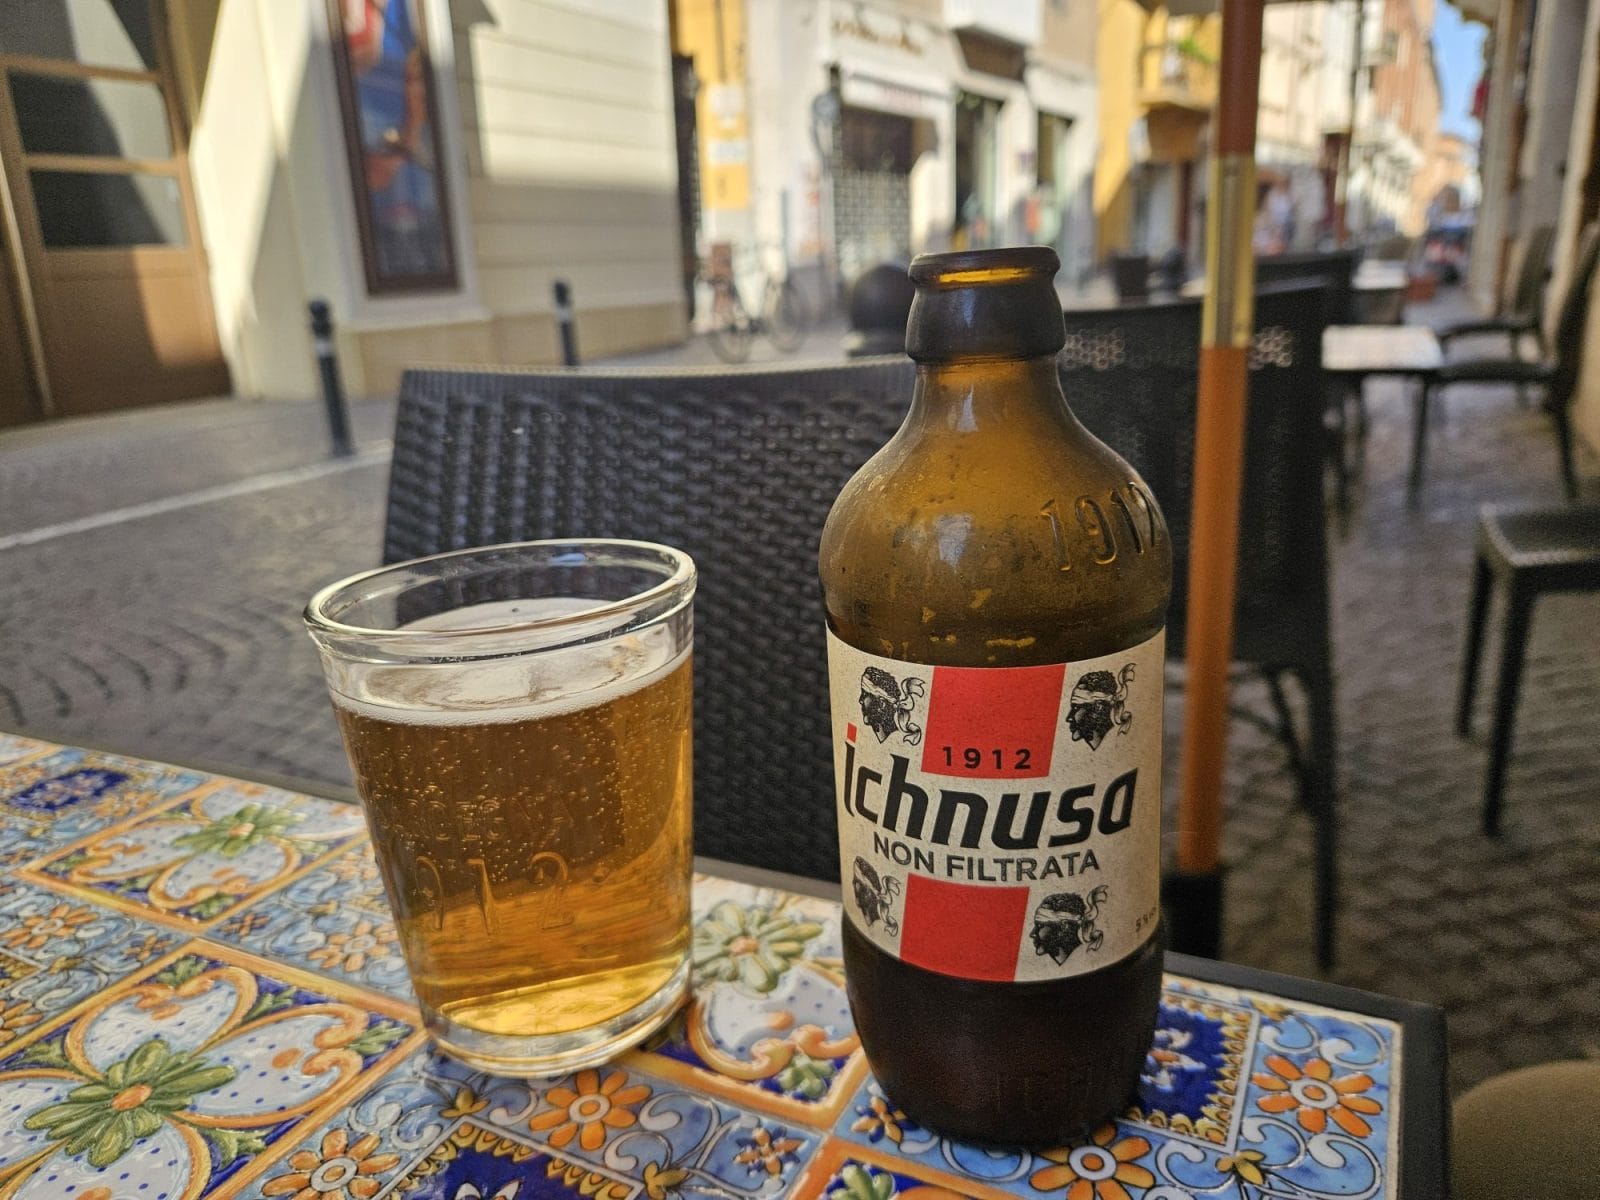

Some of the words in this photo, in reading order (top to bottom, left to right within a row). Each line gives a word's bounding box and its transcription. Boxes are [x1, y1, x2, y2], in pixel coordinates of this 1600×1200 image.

[942, 746, 1031, 770] 1912
[844, 722, 1138, 850] ichnusa
[873, 831, 935, 874] NON
[946, 849, 1100, 882] FILTRATA
